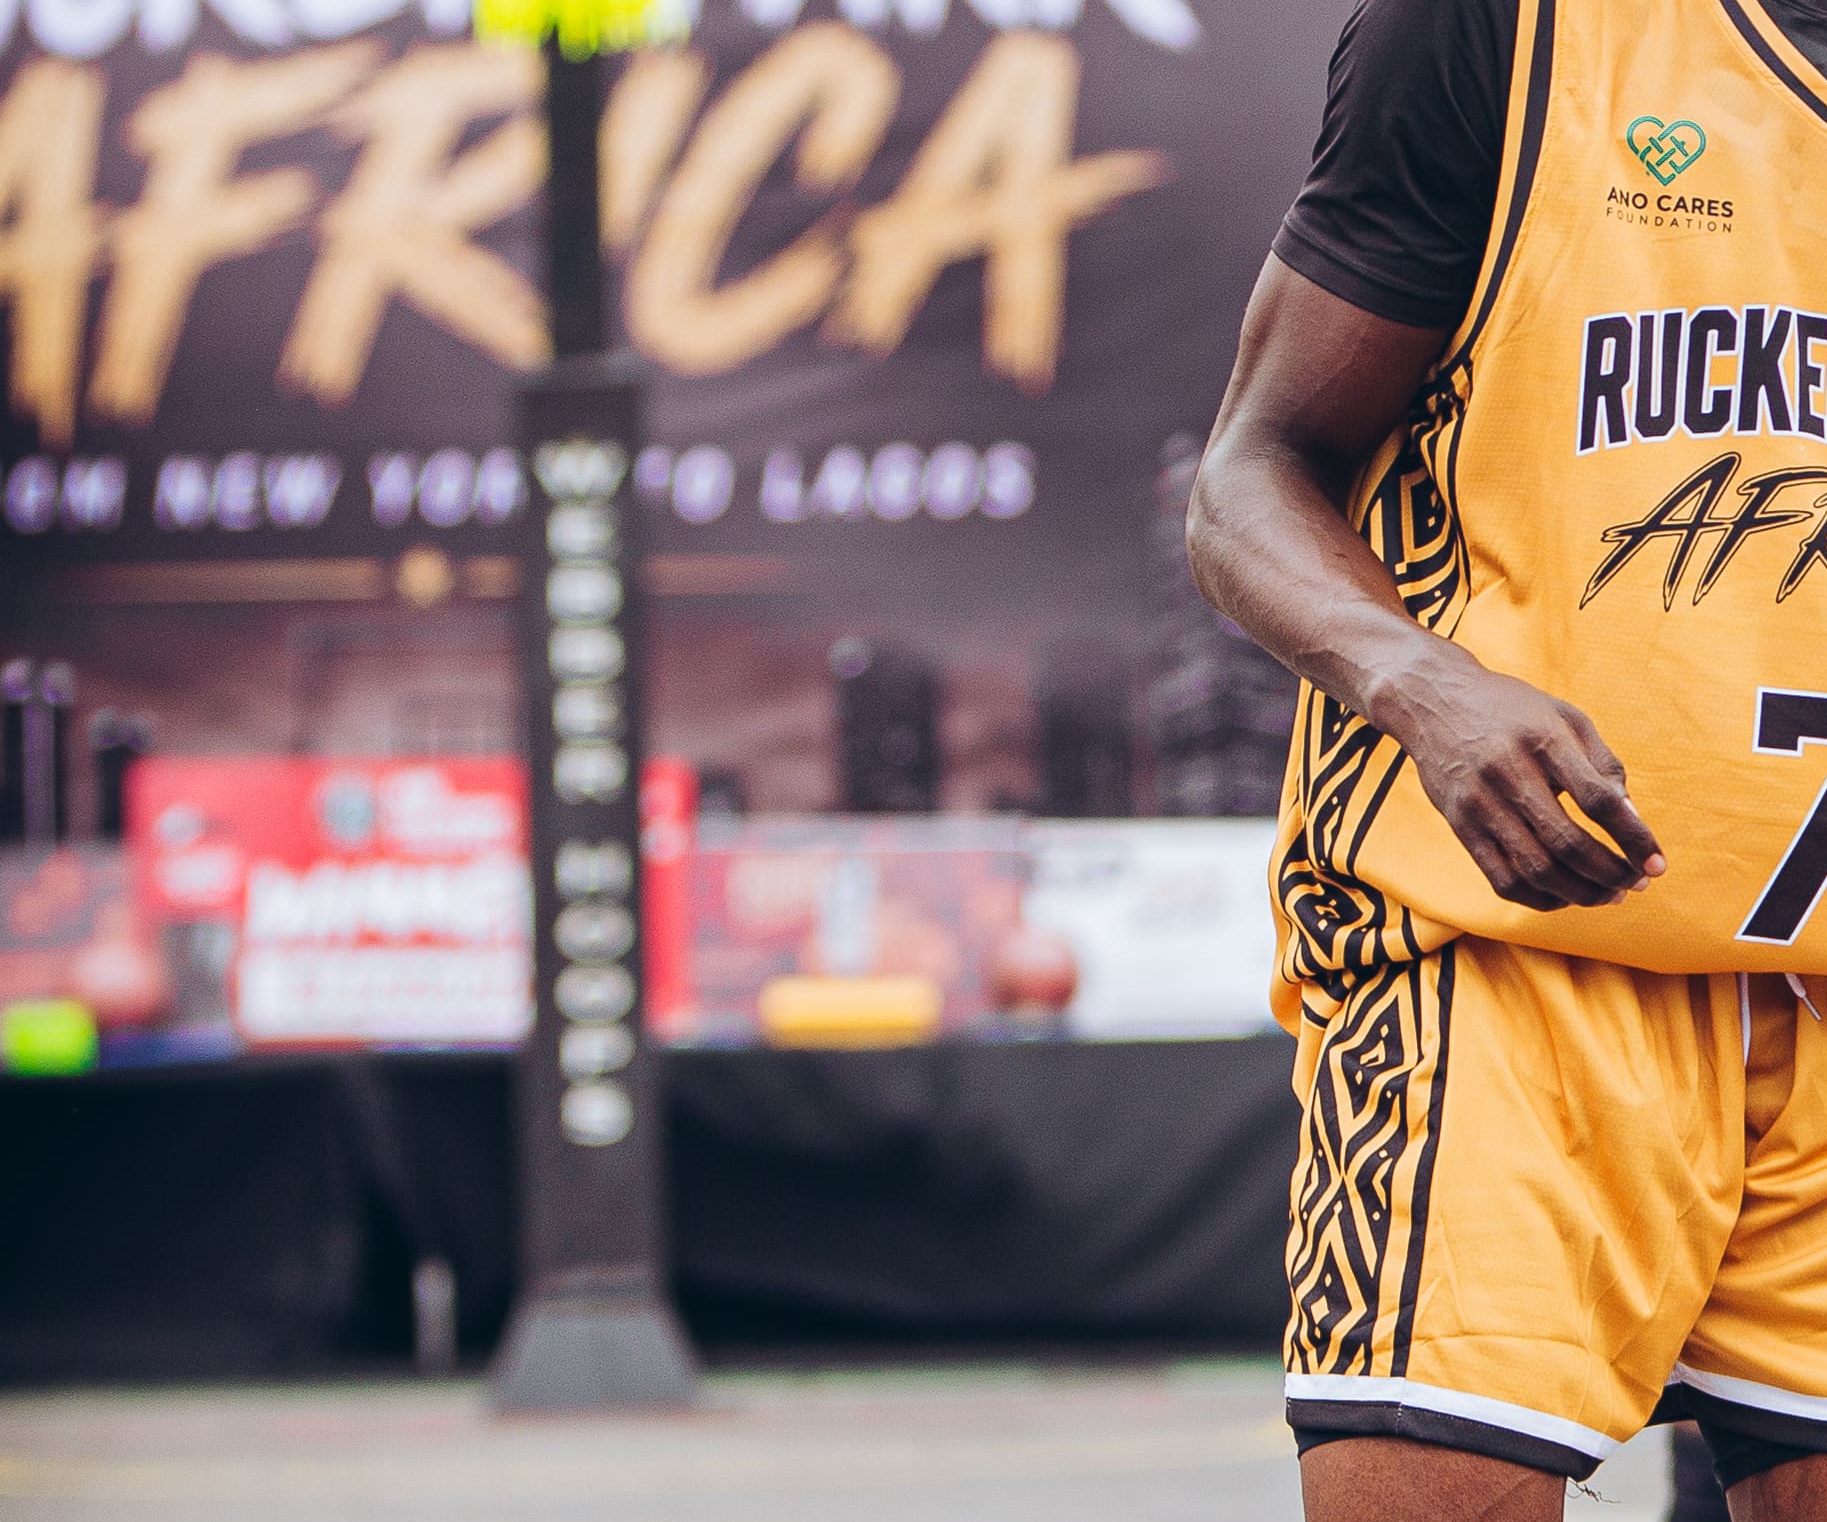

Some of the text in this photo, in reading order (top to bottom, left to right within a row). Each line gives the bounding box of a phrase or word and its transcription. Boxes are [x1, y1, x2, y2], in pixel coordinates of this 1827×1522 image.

[1607, 186, 1734, 218] ANO CARES
[1606, 207, 1732, 233] FOUNDATION
